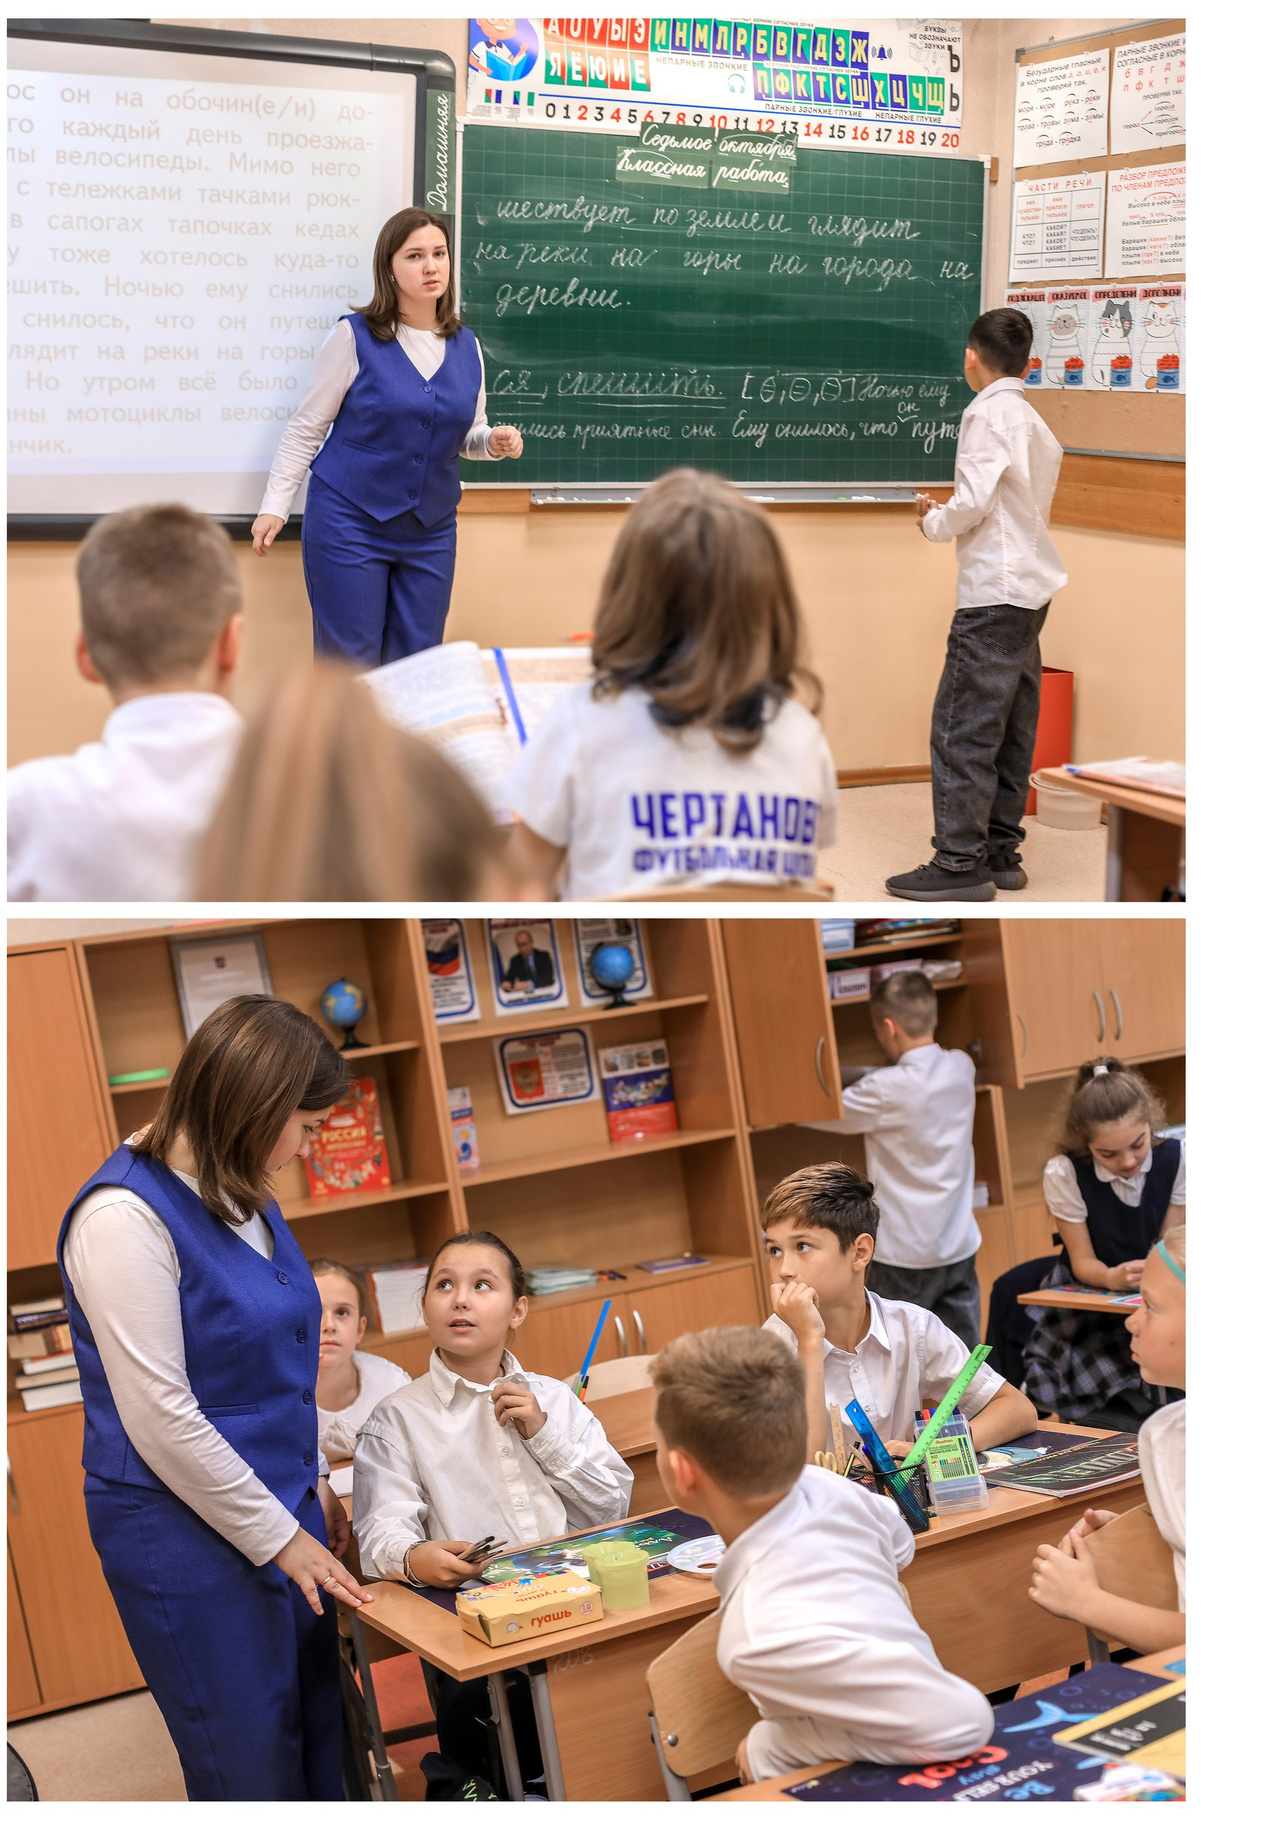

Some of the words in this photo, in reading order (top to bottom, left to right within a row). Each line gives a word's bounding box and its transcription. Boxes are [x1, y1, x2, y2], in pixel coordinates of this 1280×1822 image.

[675, 22, 687, 47] Н
[695, 24, 708, 49] М
[716, 25, 728, 50] Л
[737, 28, 747, 52] Р
[757, 30, 767, 54] Б
[776, 32, 787, 56] В
[798, 33, 807, 57] Г
[815, 34, 827, 61] Д
[852, 39, 868, 63] Ж
[919, 34, 961, 43] ОБОЗНАЧАЮТ
[1118, 46, 1146, 58] ПАРНЫЕ
[1148, 39, 1180, 52] ЗВОНКИЕ
[550, 52, 561, 76] Я
[591, 56, 606, 81] Ю
[635, 60, 647, 84] Е
[656, 57, 705, 68] НЕПАРНЫЕ
[708, 61, 748, 71] ЗВОНКИЕ
[948, 45, 960, 72] Ъ
[1117, 53, 1158, 67] СОГЛАСНЫЕ
[757, 70, 769, 94] П
[775, 72, 790, 95] Ф
[796, 74, 808, 97] К
[816, 75, 826, 98] Т
[874, 80, 886, 103] Х
[912, 83, 923, 106] Ч
[950, 84, 959, 111] Ь
[60, 85, 90, 104] он
[115, 89, 143, 107] на
[167, 90, 316, 122] обочин(е/и)
[337, 105, 375, 122] до-
[765, 104, 796, 112] ПАРНЫЕ
[799, 106, 862, 117] ЗВОНКИЕ/ГЛУХИЕ
[546, 103, 555, 117] 0
[563, 104, 571, 119] 1
[578, 105, 588, 120] 2
[594, 107, 604, 121] 3
[610, 108, 621, 122] 4
[628, 109, 637, 123] 5
[644, 110, 654, 122] 6
[662, 112, 670, 123] 7
[676, 113, 686, 125] 8
[693, 114, 702, 126] 9
[710, 115, 727, 129] 10
[734, 117, 749, 130] 11
[757, 119, 775, 132] 12
[781, 121, 799, 134] 13
[804, 122, 822, 137] 14
[829, 124, 846, 138] 15
[852, 126, 869, 140] 16
[875, 128, 892, 142] 17
[897, 130, 915, 144] 18
[921, 131, 936, 146] 19
[941, 133, 959, 148] 20
[876, 113, 914, 121] НЕПАРНЫЕ
[916, 115, 942, 123] ГЛУХИЕ
[63, 120, 160, 141] каждый
[186, 126, 243, 146] день
[267, 131, 375, 152] проезжа-
[642, 124, 712, 151] Седьмое
[55, 148, 209, 172] велосипеды.
[229, 152, 294, 175] Мимо
[312, 161, 360, 178] него
[427, 93, 448, 211] Домашняя
[617, 149, 706, 179] Классная
[712, 160, 789, 188] работа.
[1120, 172, 1146, 181] РАЗБОР
[17, 180, 30, 195] с
[46, 180, 181, 201] тележками
[198, 186, 291, 206] тачками
[306, 190, 360, 211] рюк-
[1029, 182, 1058, 192] ЧАСТИ
[1066, 179, 1092, 188] РЕЧИ
[1124, 181, 1152, 191] ЧЛЕНАМ
[11, 213, 23, 228] в
[47, 214, 144, 233] сапогах
[167, 217, 272, 237] тапочках
[295, 222, 359, 240] кедах
[496, 195, 636, 233] шествует
[652, 207, 679, 225] по
[686, 208, 766, 238] земле
[769, 213, 792, 233] и
[808, 214, 921, 248] глядит
[49, 247, 110, 264] тоже
[139, 249, 249, 267] хотелось
[274, 252, 359, 270] куда-то
[475, 242, 514, 261] на
[516, 242, 589, 270] реки
[610, 247, 658, 267] на
[683, 250, 742, 276] горы
[768, 253, 808, 275] на
[822, 255, 923, 292] города
[939, 260, 975, 280] на
[104, 276, 184, 298] Ночью
[206, 282, 248, 302] ему
[268, 283, 358, 300] снились
[496, 277, 631, 317] деревни.
[23, 313, 130, 332] снилось,
[155, 314, 194, 331] что
[218, 314, 246, 330] он
[97, 345, 125, 361] на
[143, 345, 199, 365] реки
[217, 344, 243, 361] на
[261, 344, 315, 364] горы
[26, 371, 59, 391] Но
[83, 374, 156, 395] утром
[179, 373, 216, 391] всё
[239, 369, 298, 390] было
[67, 407, 201, 425] мотоциклы
[573, 423, 673, 450] приятные
[731, 409, 769, 448] Ему
[775, 421, 855, 441] снилось,
[859, 420, 898, 437] что
[531, 1610, 571, 1627] гуашь
[582, 1603, 591, 1611] 12
